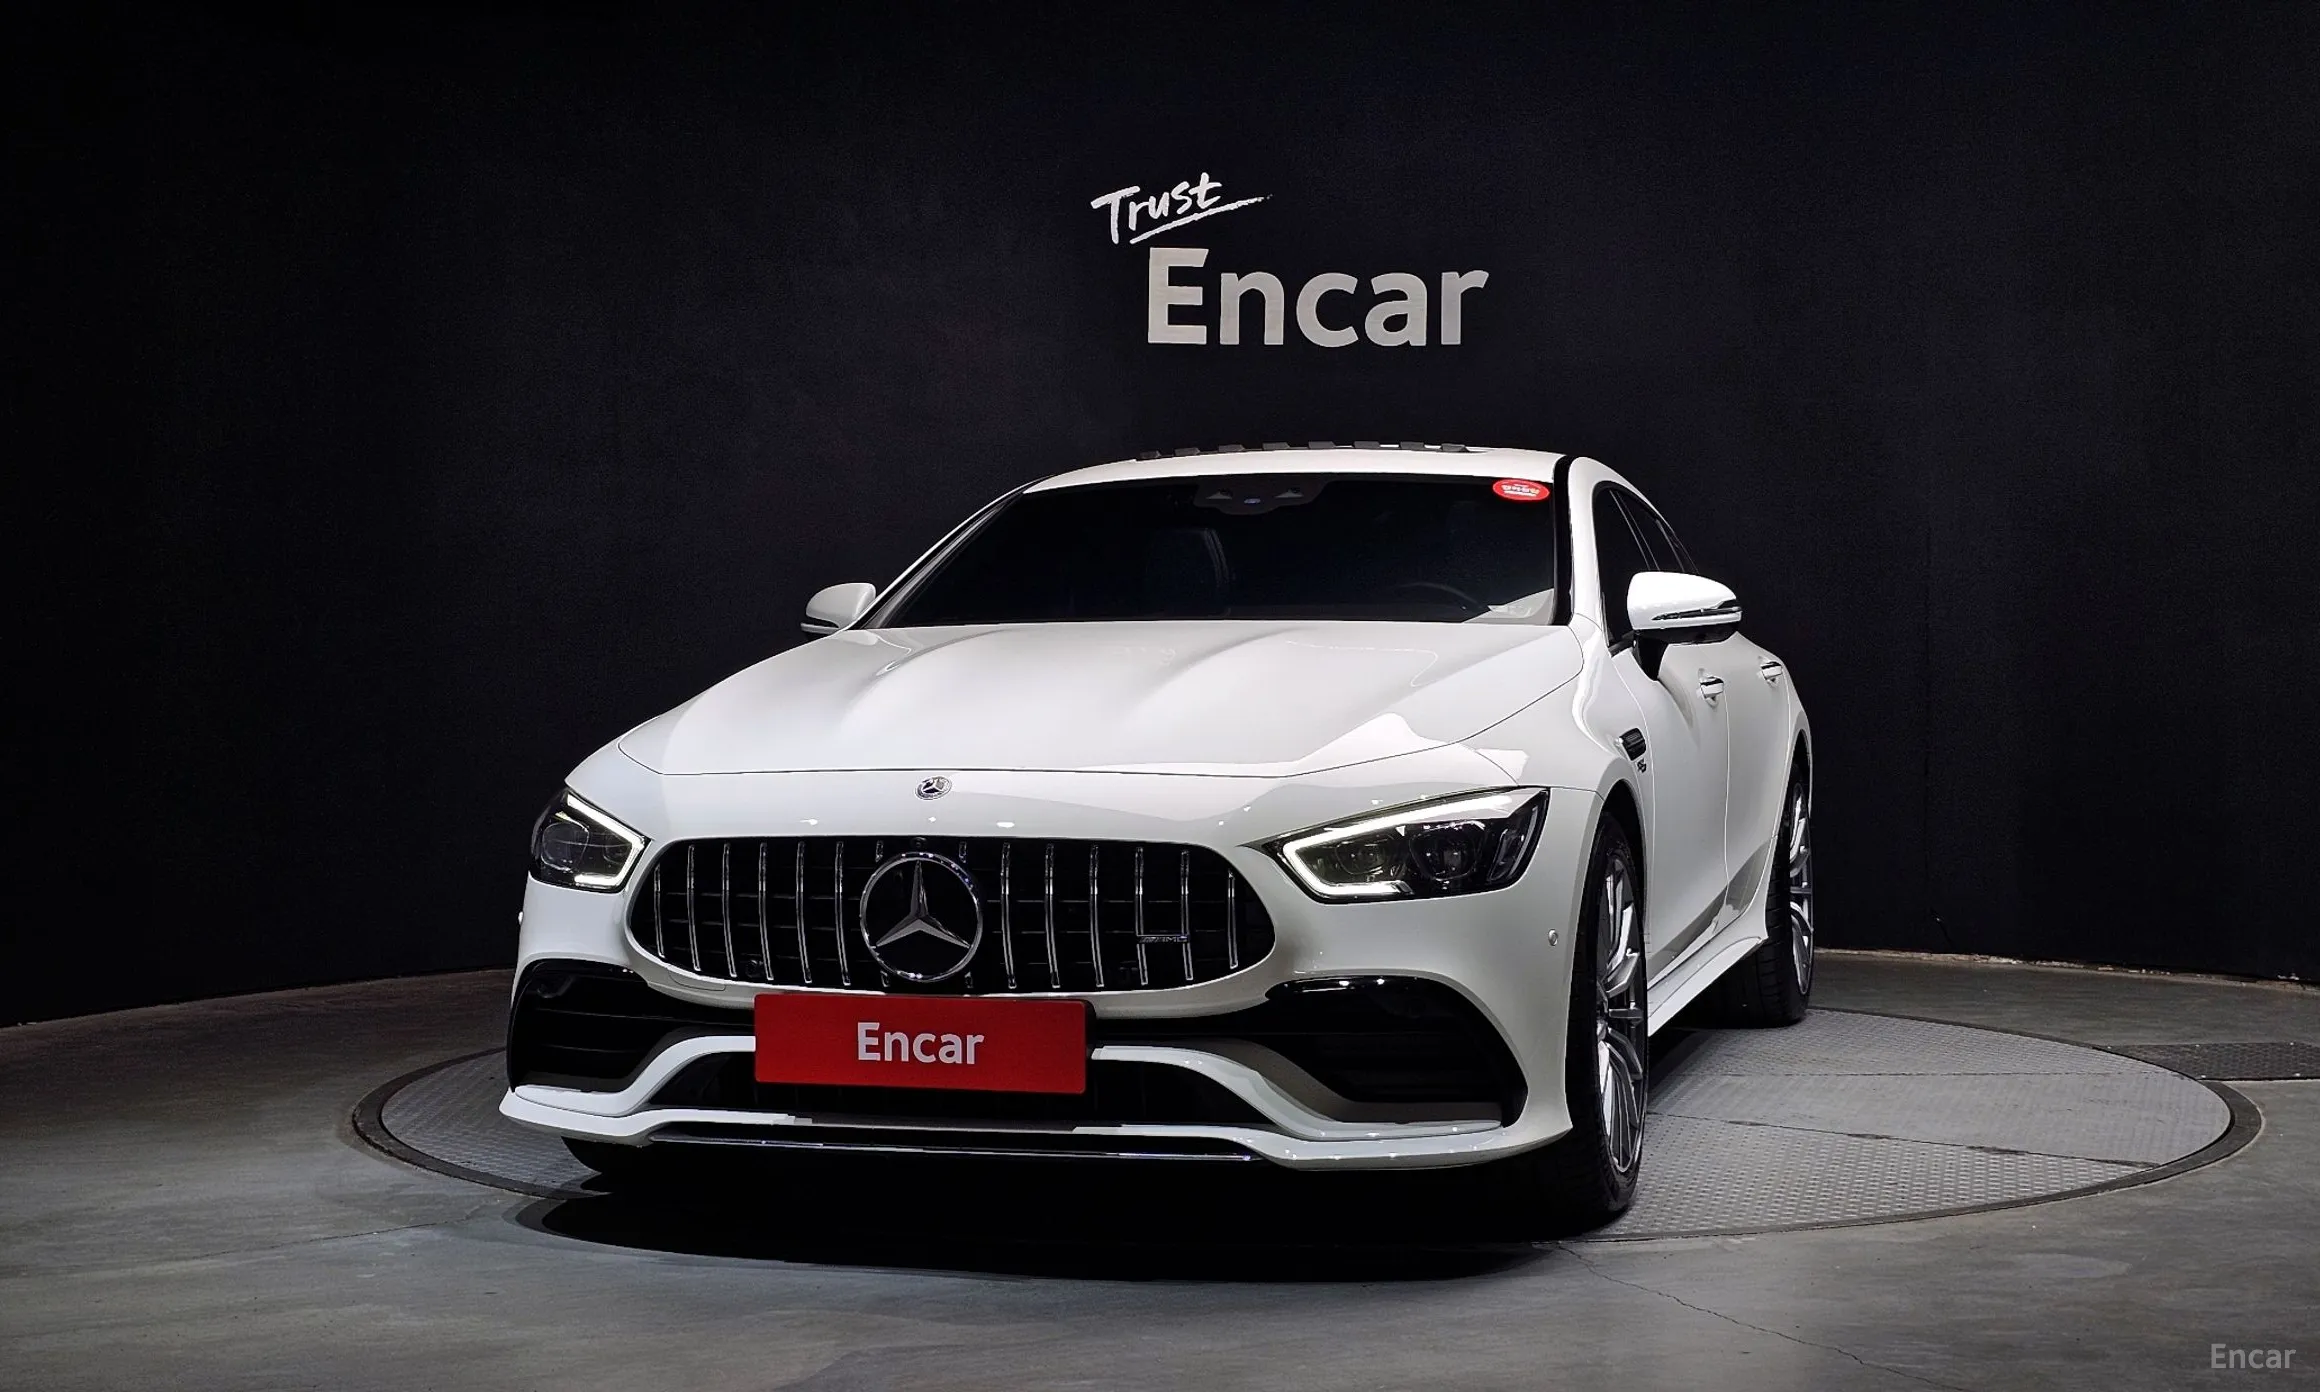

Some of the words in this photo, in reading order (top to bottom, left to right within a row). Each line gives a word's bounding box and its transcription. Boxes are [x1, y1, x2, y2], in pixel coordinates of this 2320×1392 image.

[1090, 172, 1224, 245] Trust
[1148, 247, 1489, 347] Encar
[858, 1022, 985, 1064] Encar
